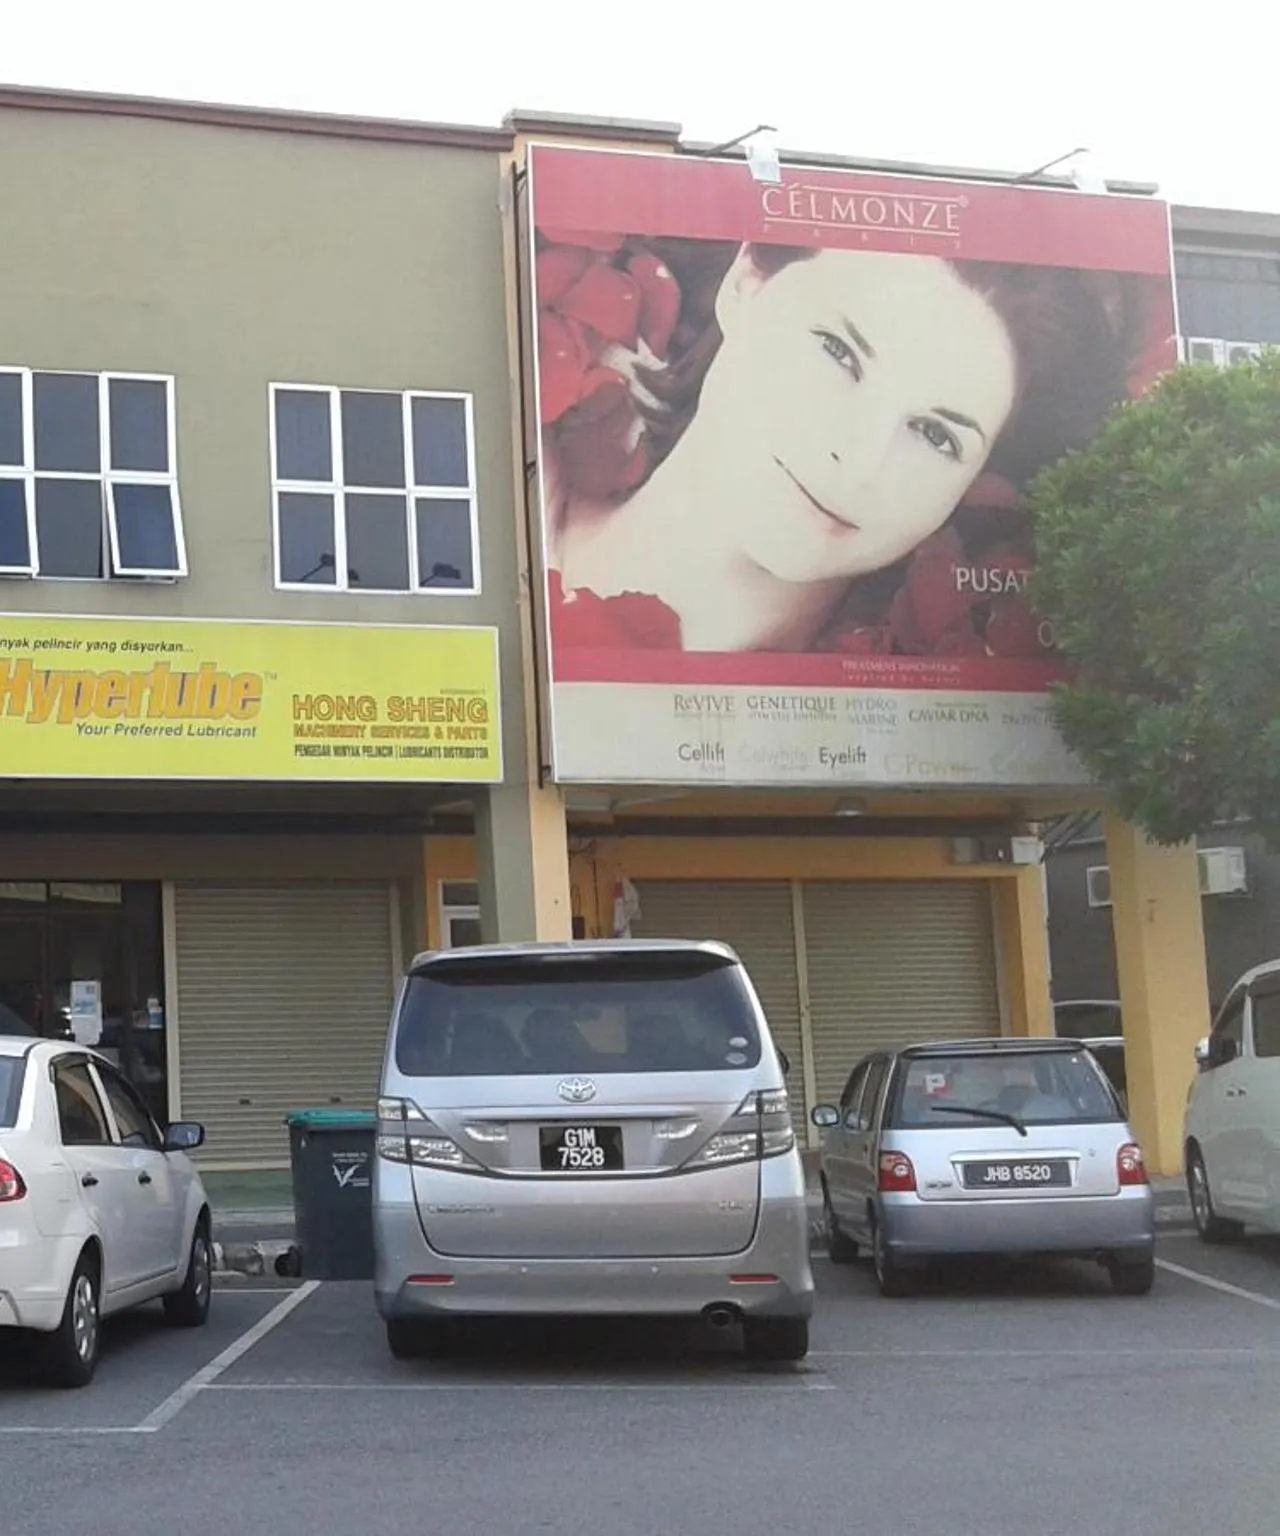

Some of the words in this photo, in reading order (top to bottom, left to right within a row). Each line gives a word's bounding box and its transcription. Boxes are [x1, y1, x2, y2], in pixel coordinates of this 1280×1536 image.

[762, 182, 960, 231] CÉLMONZE
[33, 637, 81, 651] pelincir
[85, 640, 118, 653] yang
[292, 693, 378, 722] HONG
[386, 695, 489, 724] SHENG
[674, 694, 735, 711] ReVIVE
[746, 695, 837, 712] GENETIQUE
[845, 696, 898, 711] HYDRO
[76, 722, 109, 736] Your
[114, 723, 182, 738] Preferred
[186, 723, 258, 739] Lubricant
[819, 746, 867, 768] Eyelift
[925, 1074, 946, 1094] P
[557, 1146, 605, 1167] 7528
[983, 1166, 1011, 1182] JHB
[1013, 1165, 1051, 1181] 8520
